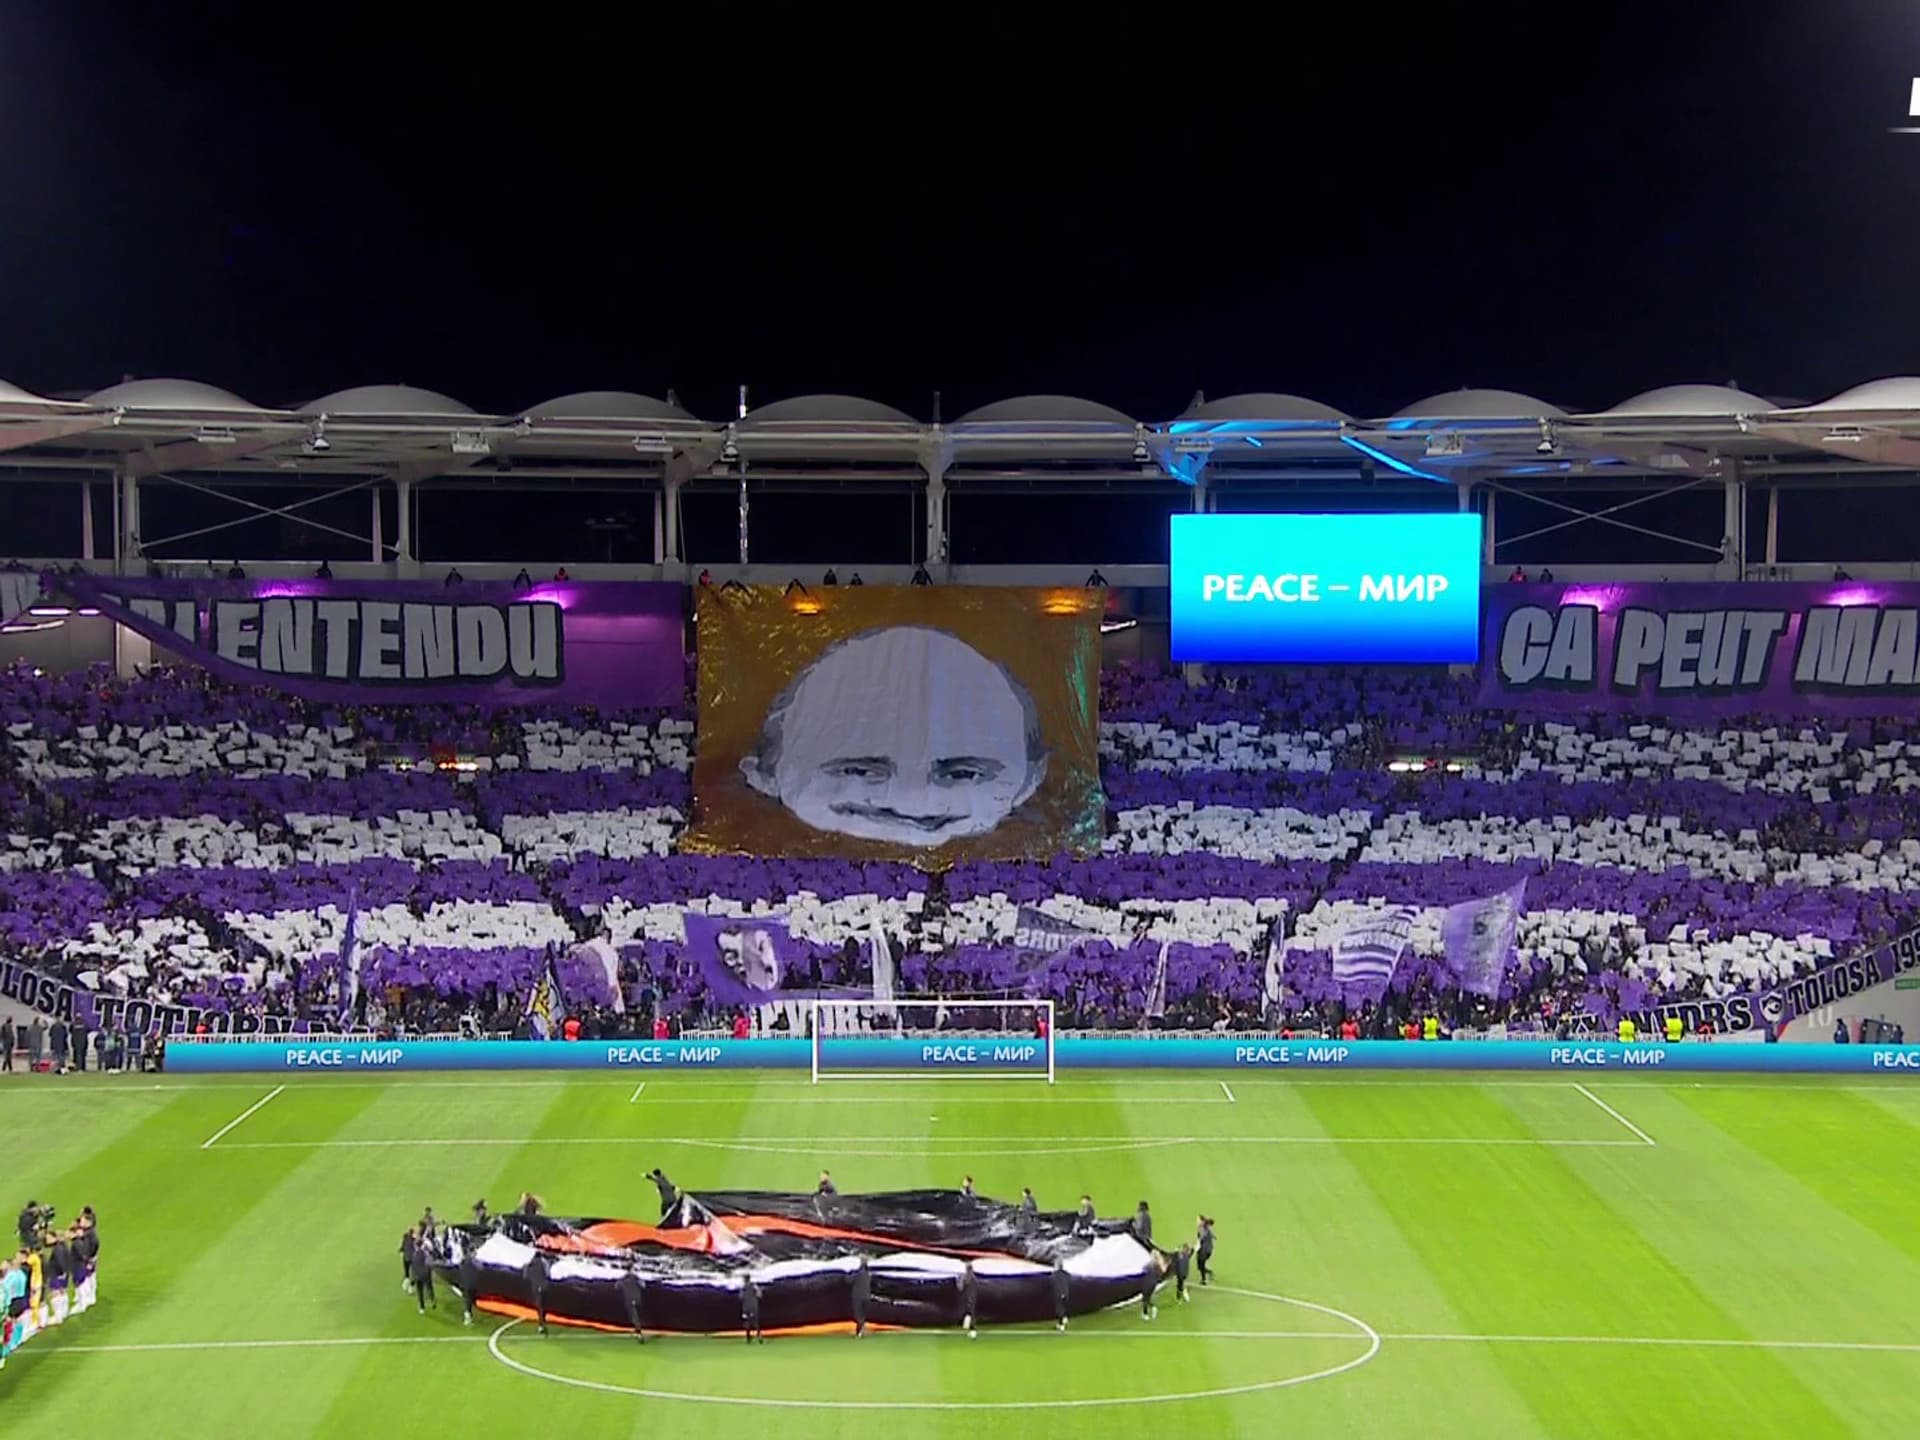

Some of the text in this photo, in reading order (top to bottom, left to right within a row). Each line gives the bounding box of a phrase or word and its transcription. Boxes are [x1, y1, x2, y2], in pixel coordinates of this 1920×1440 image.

[1203, 573, 1320, 602] PEACE
[1358, 574, 1449, 602] МИР
[1613, 606, 1786, 688] PEUT
[1795, 605, 1920, 687] MA
[1787, 952, 1880, 1018] TOLOSA
[287, 1050, 342, 1065] PEACE
[360, 1049, 402, 1065] МИР
[608, 1047, 662, 1062] PEACE
[680, 1047, 721, 1062] МИР
[923, 1046, 977, 1061] PEACE
[993, 1046, 1034, 1061] МИР
[1235, 1047, 1289, 1062] PEACE
[1307, 1047, 1348, 1062] МИР
[1551, 1049, 1606, 1064] PEACE
[1623, 1050, 1665, 1064] МИР
